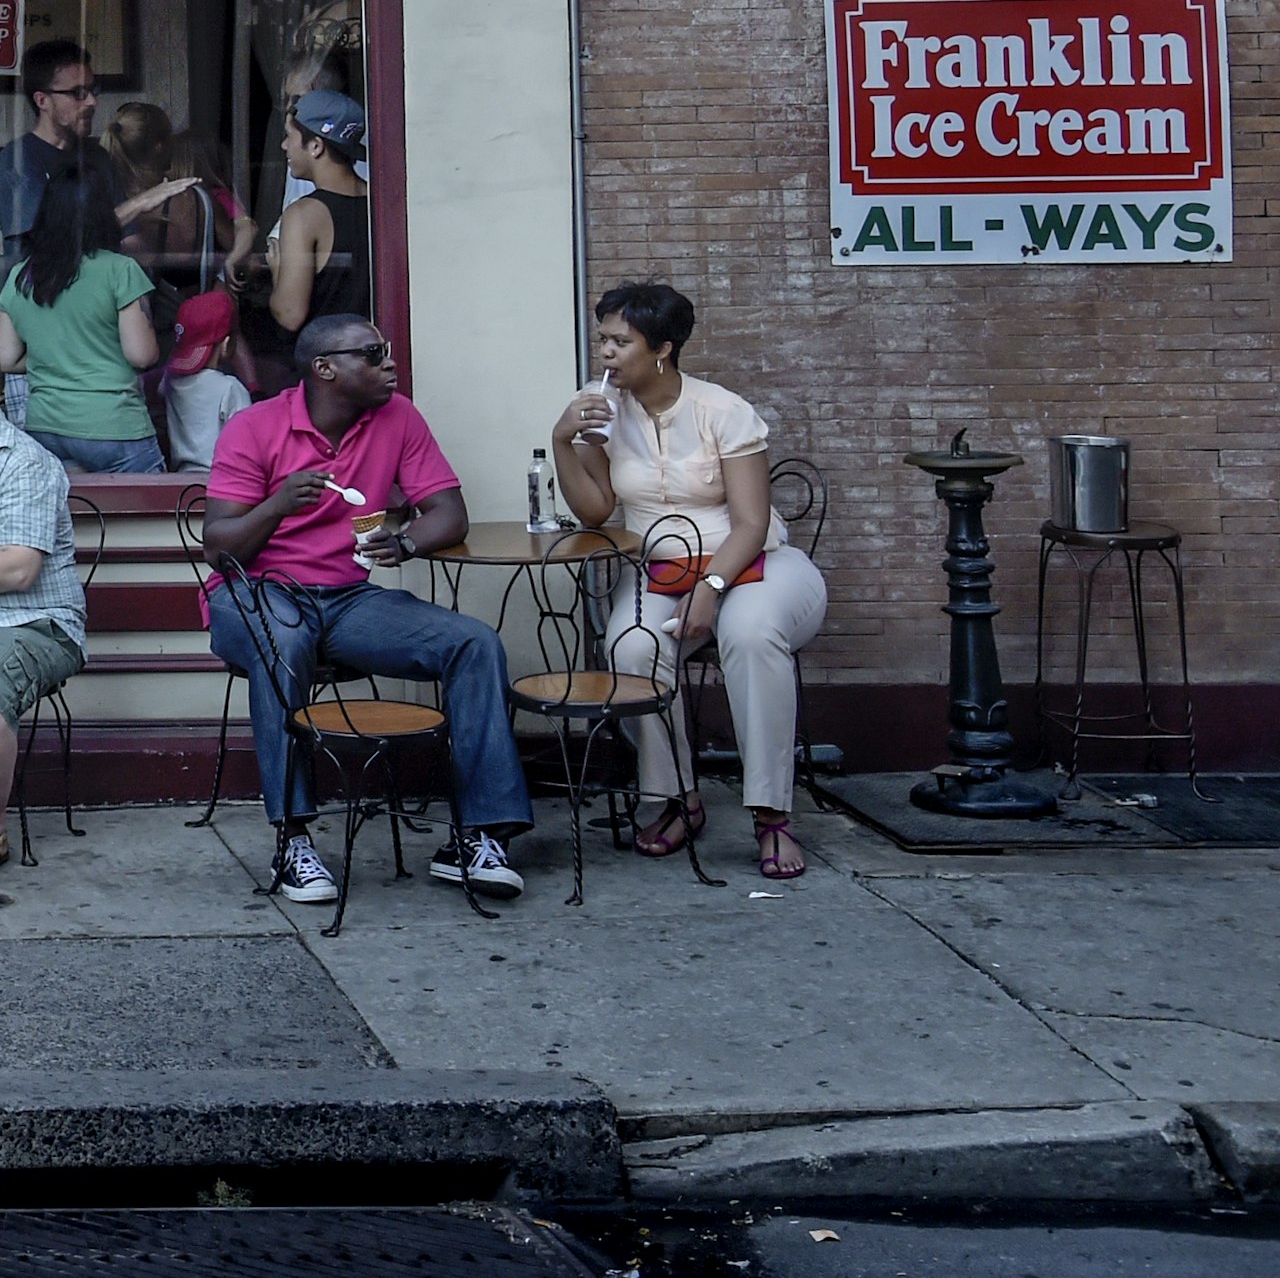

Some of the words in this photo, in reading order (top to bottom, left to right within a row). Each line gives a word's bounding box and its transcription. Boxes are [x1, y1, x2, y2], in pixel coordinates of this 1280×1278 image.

[858, 14, 1192, 89] Franklin
[869, 95, 966, 159] Ice
[975, 92, 1191, 157] Cream
